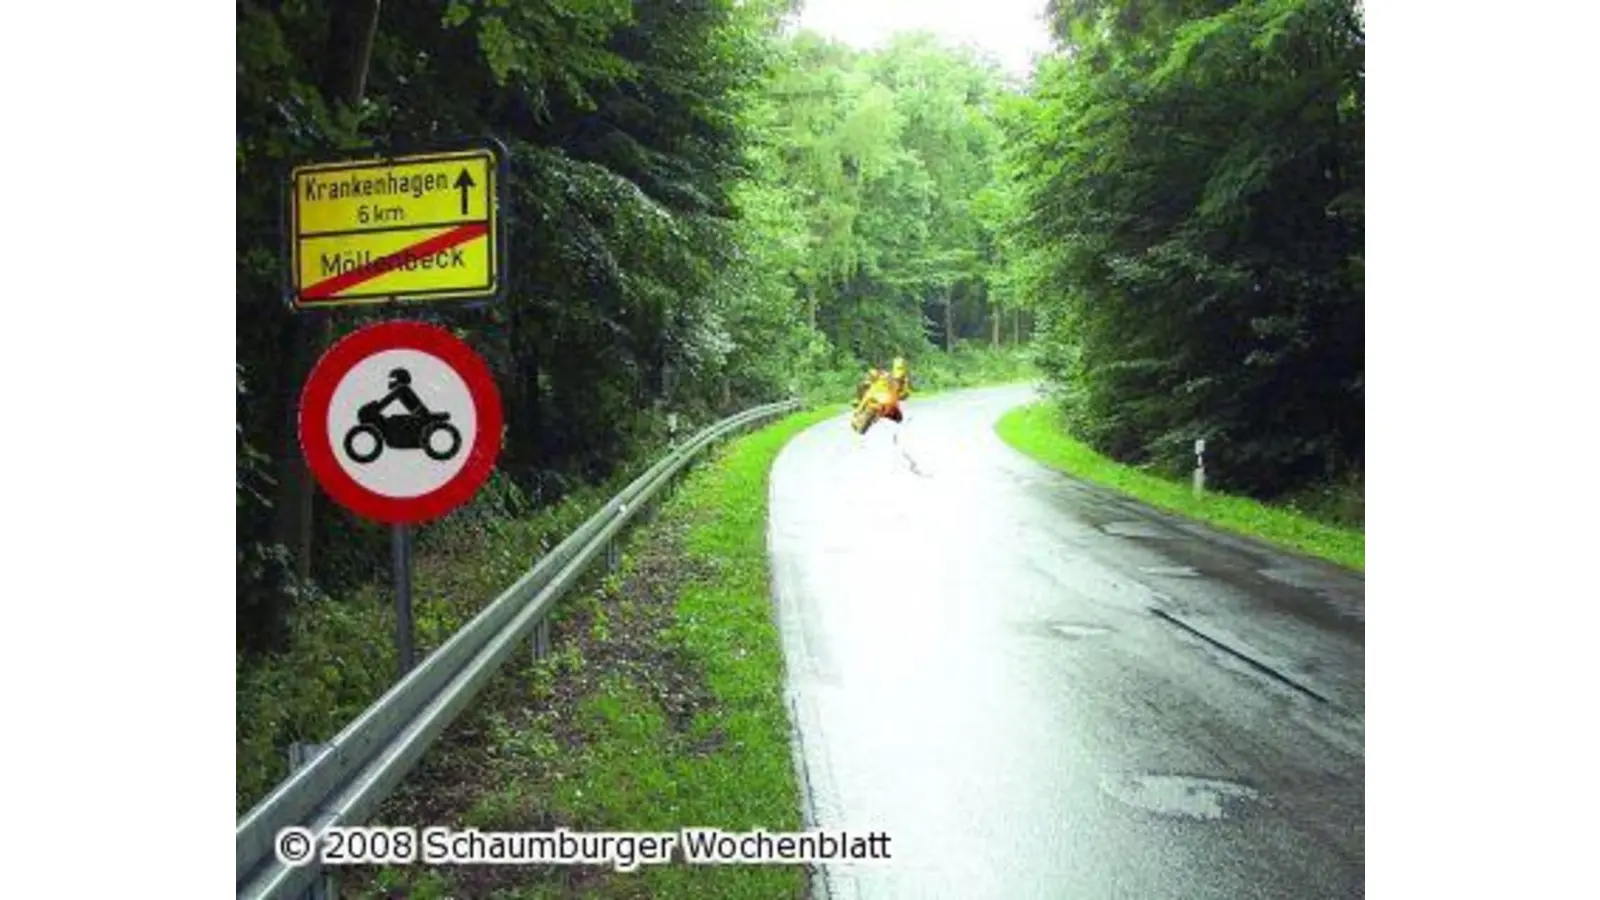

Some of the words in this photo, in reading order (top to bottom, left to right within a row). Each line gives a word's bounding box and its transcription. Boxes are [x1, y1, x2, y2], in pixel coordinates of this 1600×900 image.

[304, 172, 448, 201] Krankenhagen
[357, 205, 370, 224] 6
[373, 204, 405, 222] km
